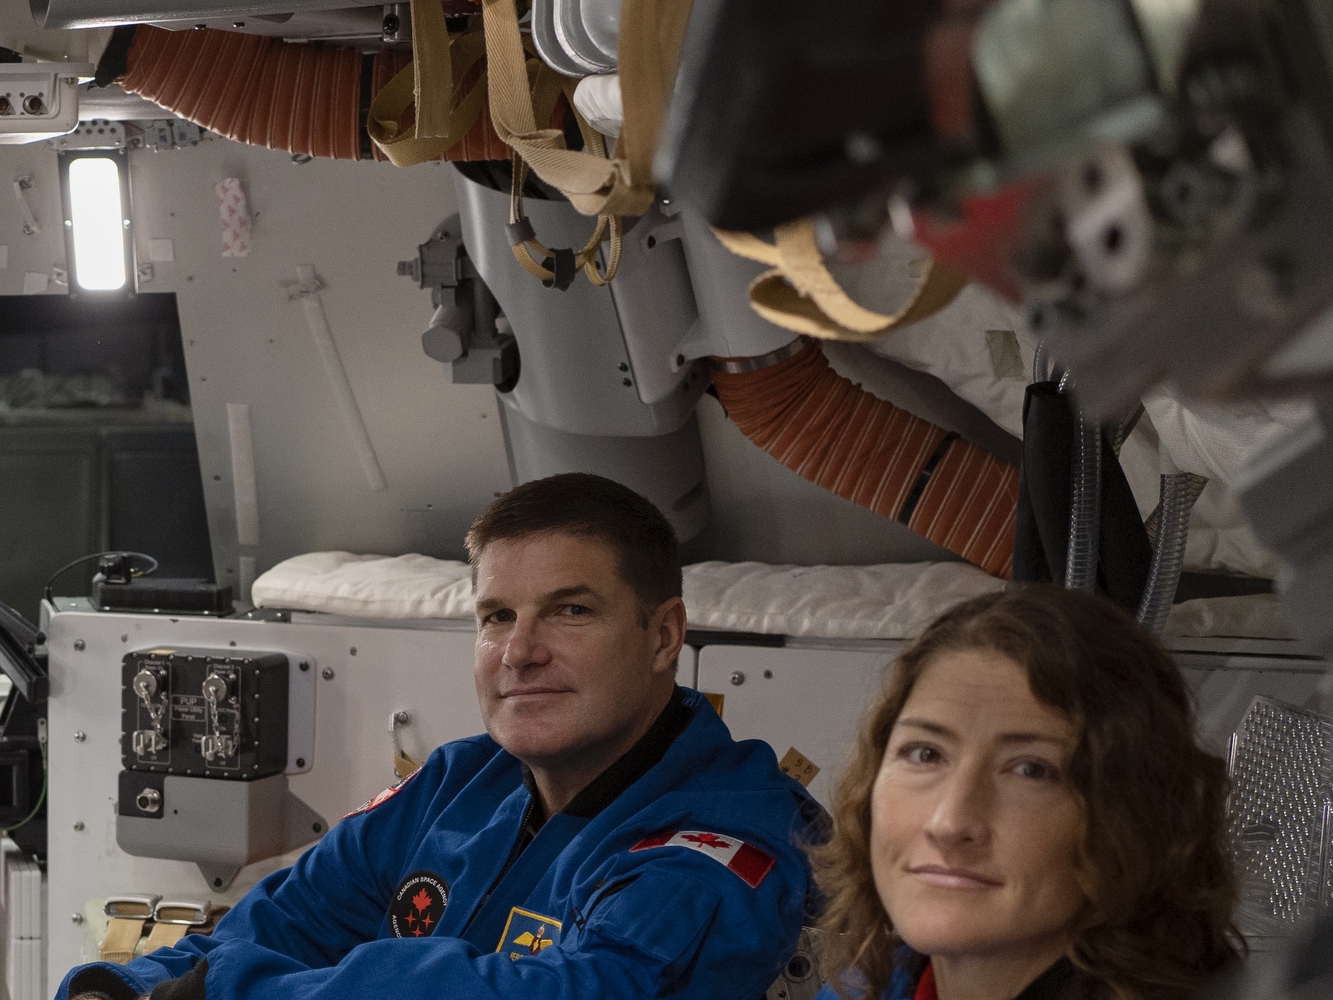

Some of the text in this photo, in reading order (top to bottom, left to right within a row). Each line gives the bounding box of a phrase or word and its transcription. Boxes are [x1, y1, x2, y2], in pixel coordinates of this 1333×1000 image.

[180, 697, 197, 705] PUP
[397, 877, 419, 900] CANADIAN
[420, 877, 437, 887] SPACE
[392, 915, 402, 938] AGENC
